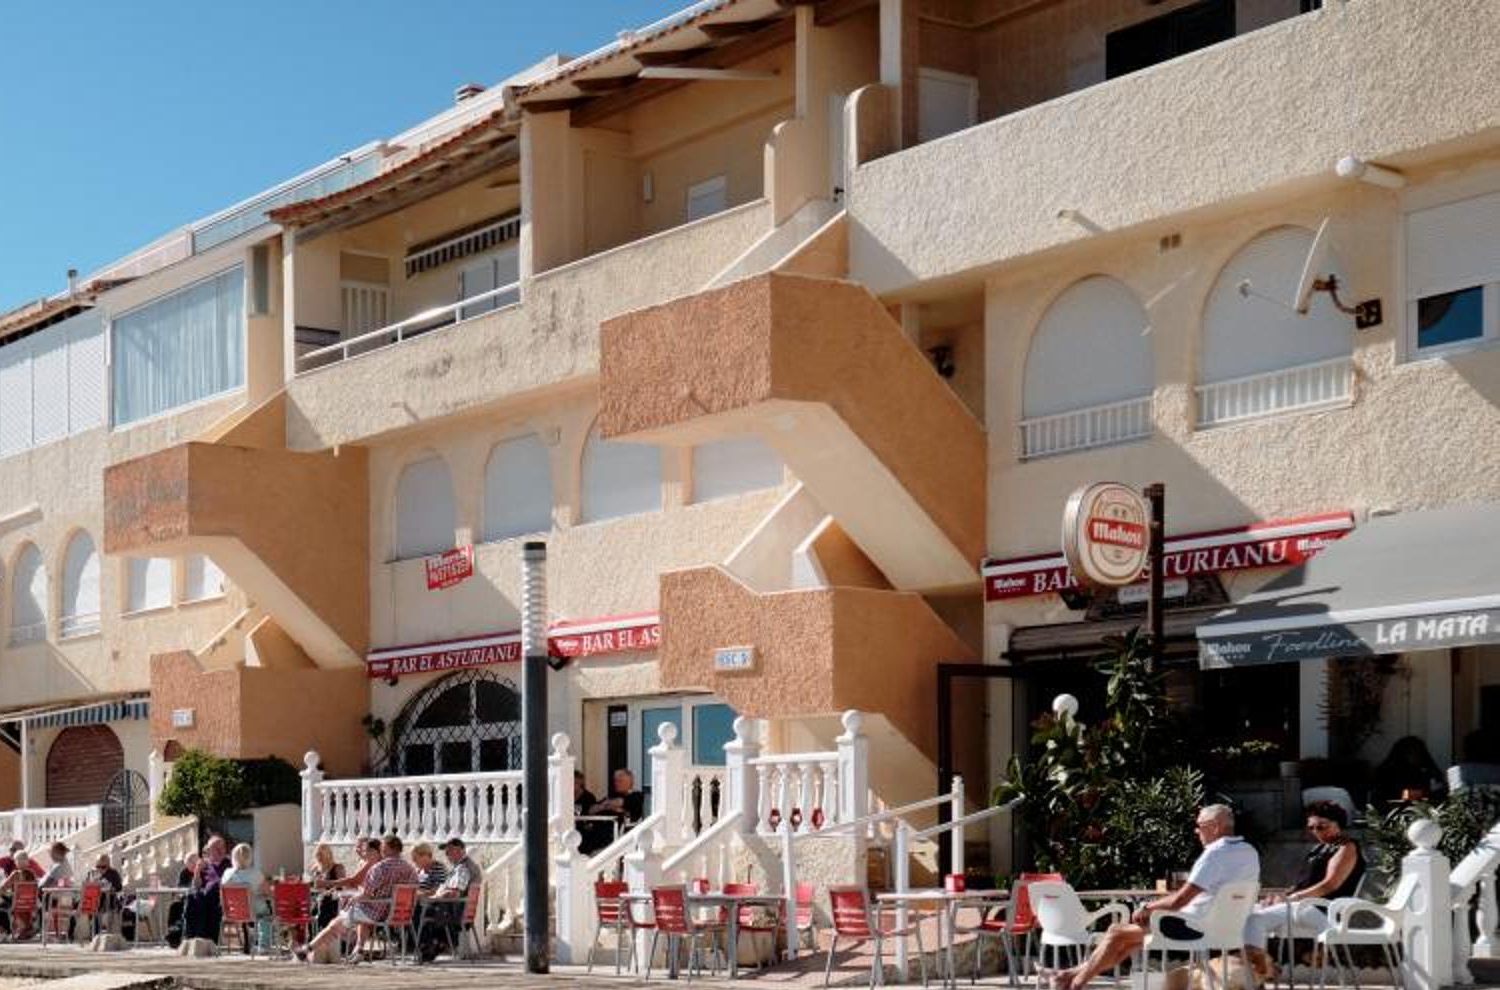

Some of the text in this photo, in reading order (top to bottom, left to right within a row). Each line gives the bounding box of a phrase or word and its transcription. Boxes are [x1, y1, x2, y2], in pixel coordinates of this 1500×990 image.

[1092, 520, 1142, 545] Mahou
[1141, 539, 1287, 580] TURIANU
[582, 631, 614, 651] BAR
[617, 629, 635, 647] EL
[1376, 621, 1408, 645] LA
[1415, 613, 1489, 641] MATA
[391, 656, 418, 674] BAR
[419, 654, 434, 671] EL
[436, 644, 517, 669] ASTURIANU
